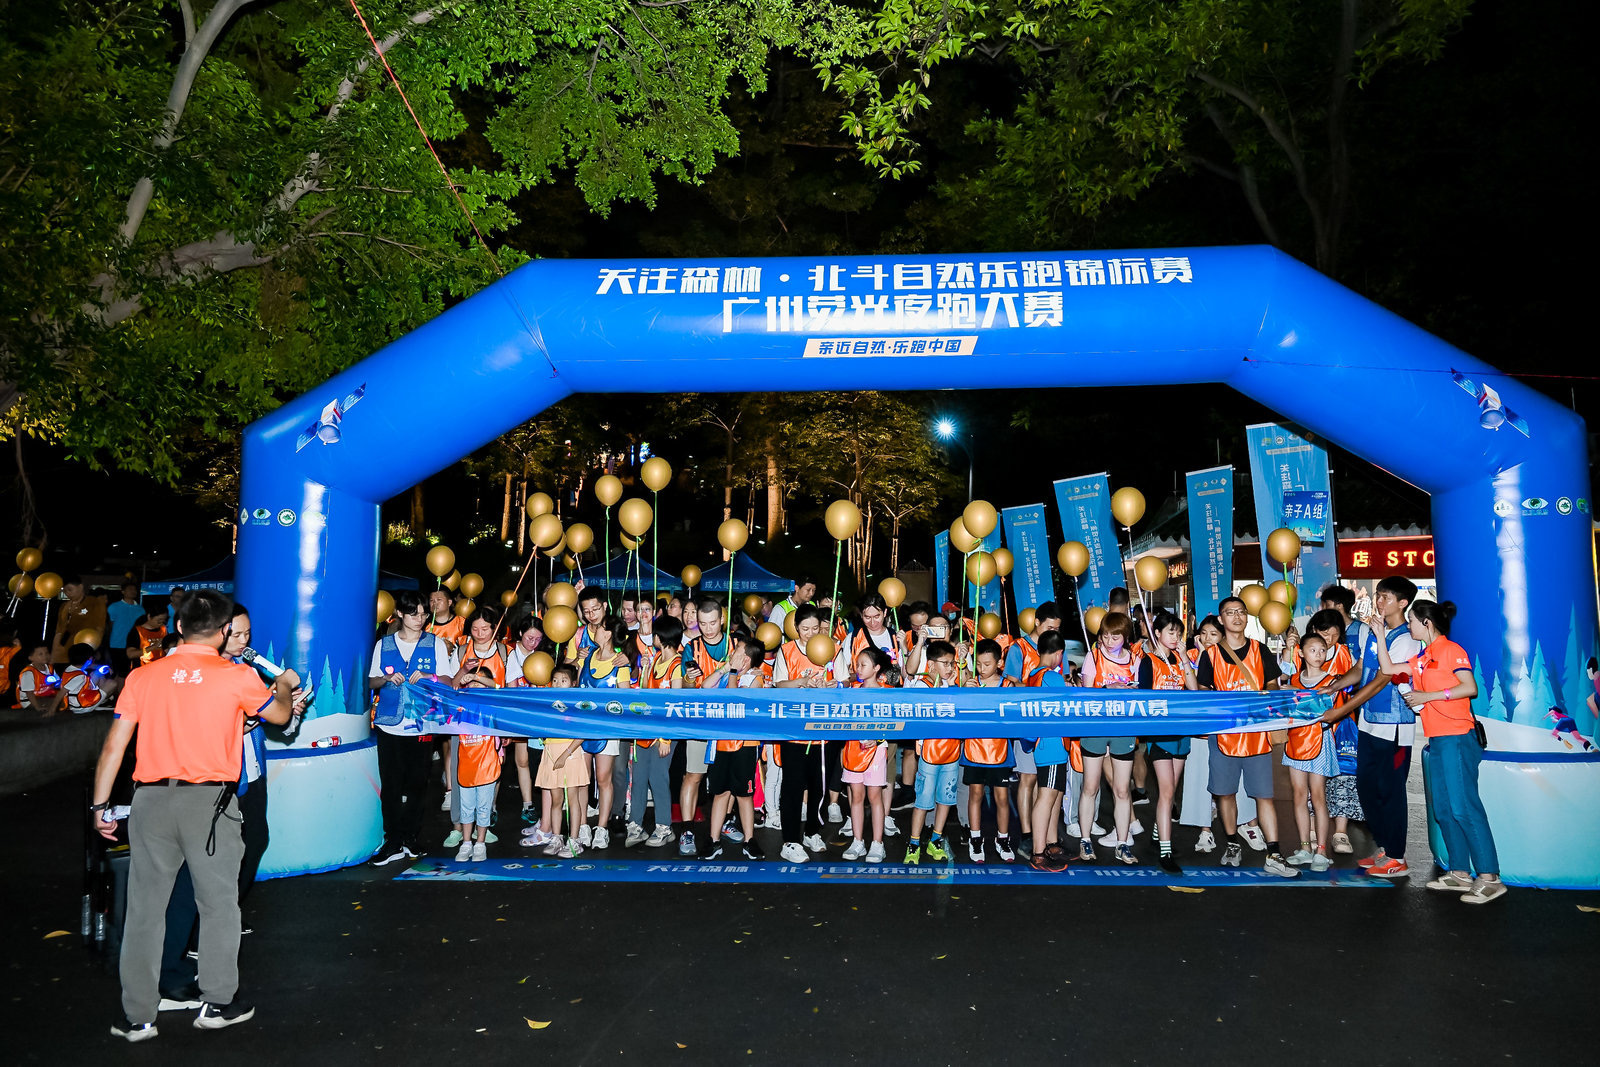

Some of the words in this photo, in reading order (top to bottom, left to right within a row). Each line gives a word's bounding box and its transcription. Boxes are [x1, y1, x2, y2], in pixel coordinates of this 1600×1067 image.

[721, 291, 1064, 333] 广州荧光夜跑大赛
[1284, 503, 1323, 519] 亲子A组
[1353, 551, 1369, 567] 店
[747, 780, 753, 793] 1
